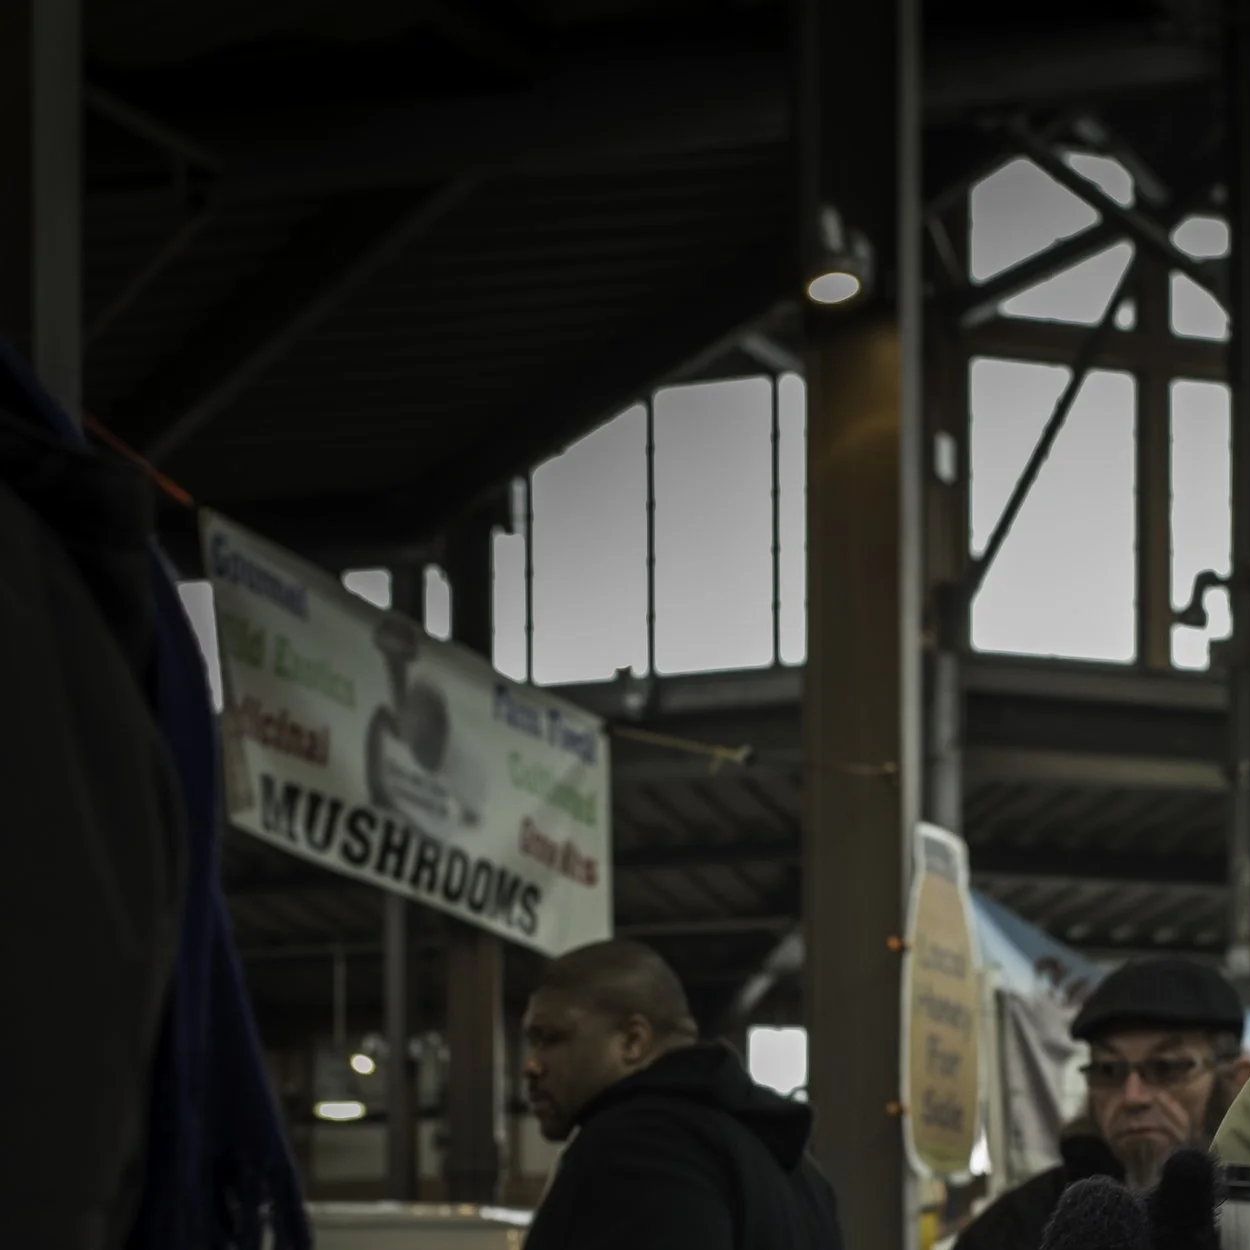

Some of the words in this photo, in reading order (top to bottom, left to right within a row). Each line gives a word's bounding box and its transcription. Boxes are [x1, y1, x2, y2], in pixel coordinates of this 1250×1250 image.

[260, 774, 543, 937] MUSHROOMS
[925, 1033, 964, 1076] For
[921, 1088, 965, 1134] Sale
